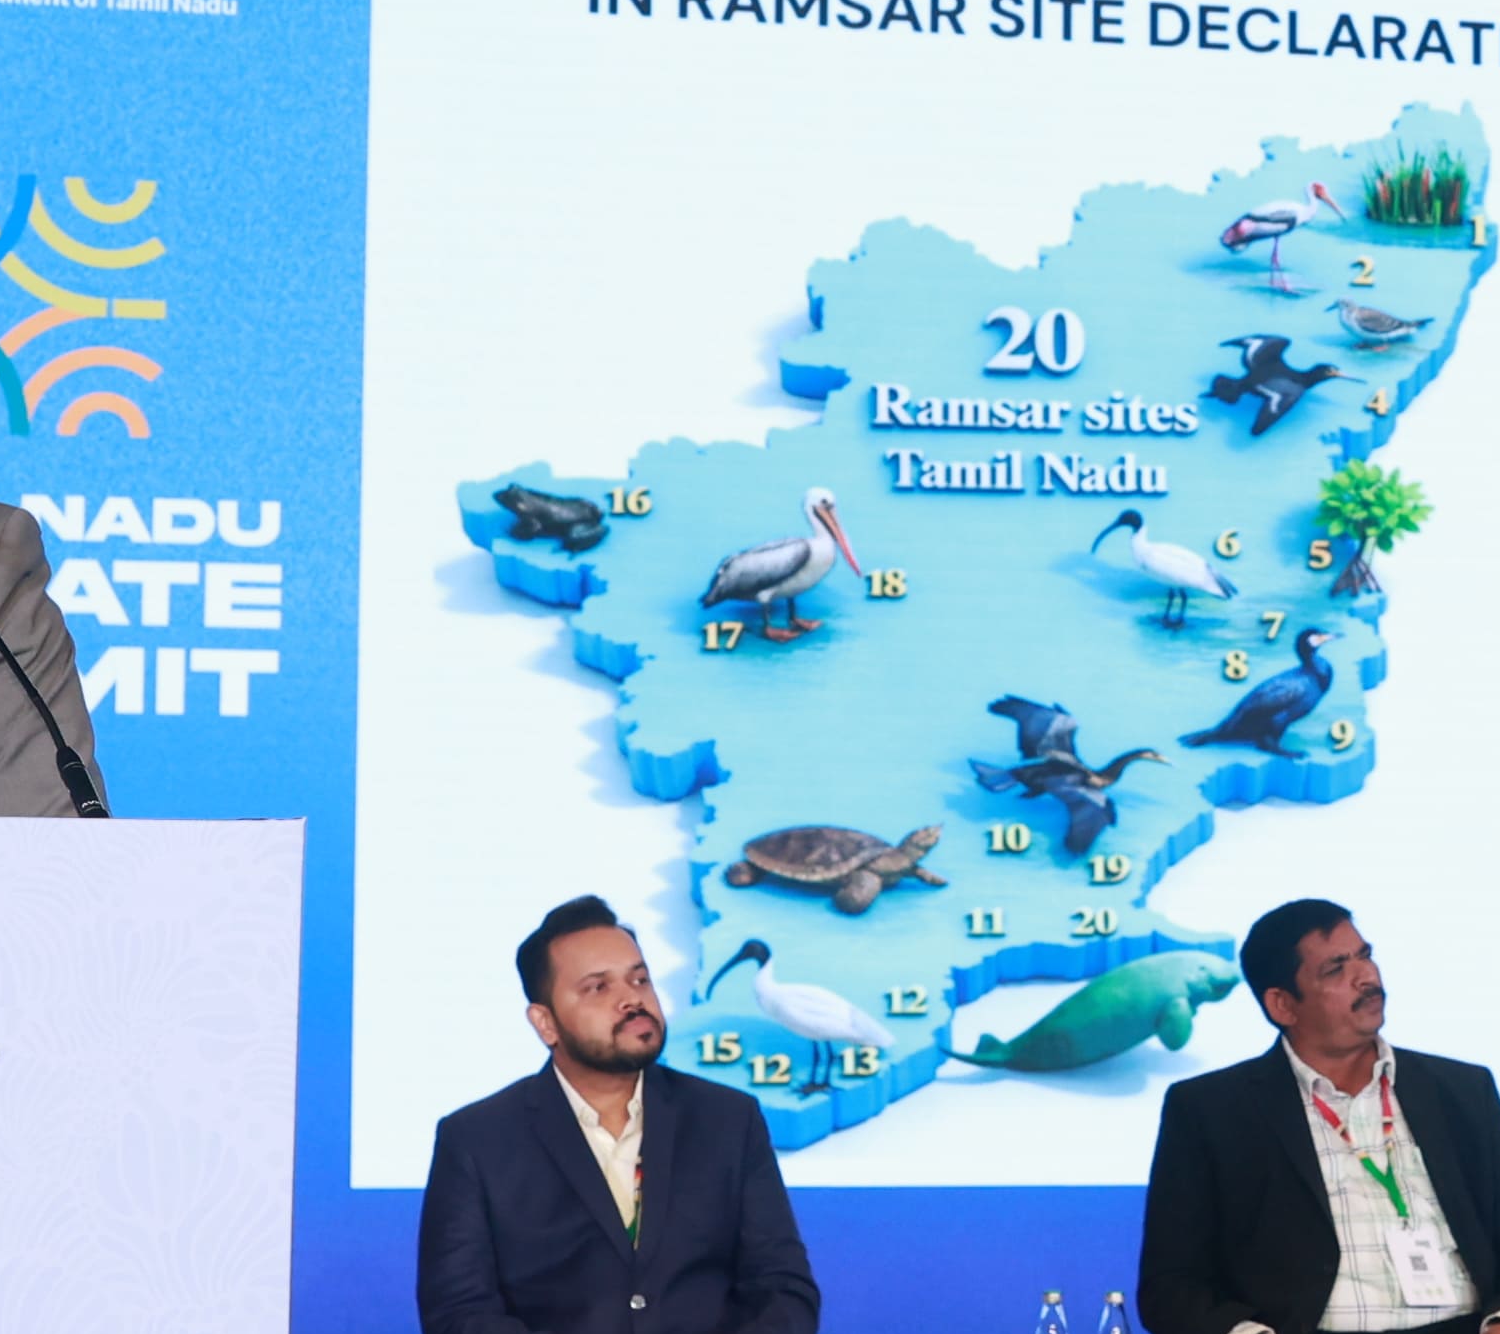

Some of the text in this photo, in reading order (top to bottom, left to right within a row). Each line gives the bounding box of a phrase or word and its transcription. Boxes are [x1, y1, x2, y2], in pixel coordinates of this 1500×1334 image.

[1470, 216, 1487, 247] 1
[1350, 256, 1374, 286] 2
[982, 306, 1085, 373] 20
[871, 383, 1199, 435] Ramsar sites
[1366, 388, 1389, 417] 4
[885, 449, 1167, 496] Tamil Nadu
[608, 487, 652, 516] 16
[20, 494, 282, 548] NADU
[1214, 530, 1241, 559] 6
[1308, 539, 1333, 570] 5
[866, 570, 906, 599] 18
[702, 622, 743, 651] 17
[1261, 610, 1286, 642] 7
[1223, 650, 1249, 680] 8
[1329, 720, 1355, 752] 9
[987, 823, 1031, 853] 10
[1090, 854, 1131, 885] 19
[967, 908, 1005, 937] 11
[1071, 907, 1117, 937] 20
[883, 987, 927, 1016] 12
[699, 1033, 741, 1065] 15
[839, 1047, 882, 1077] 13
[750, 1054, 791, 1085] 12
